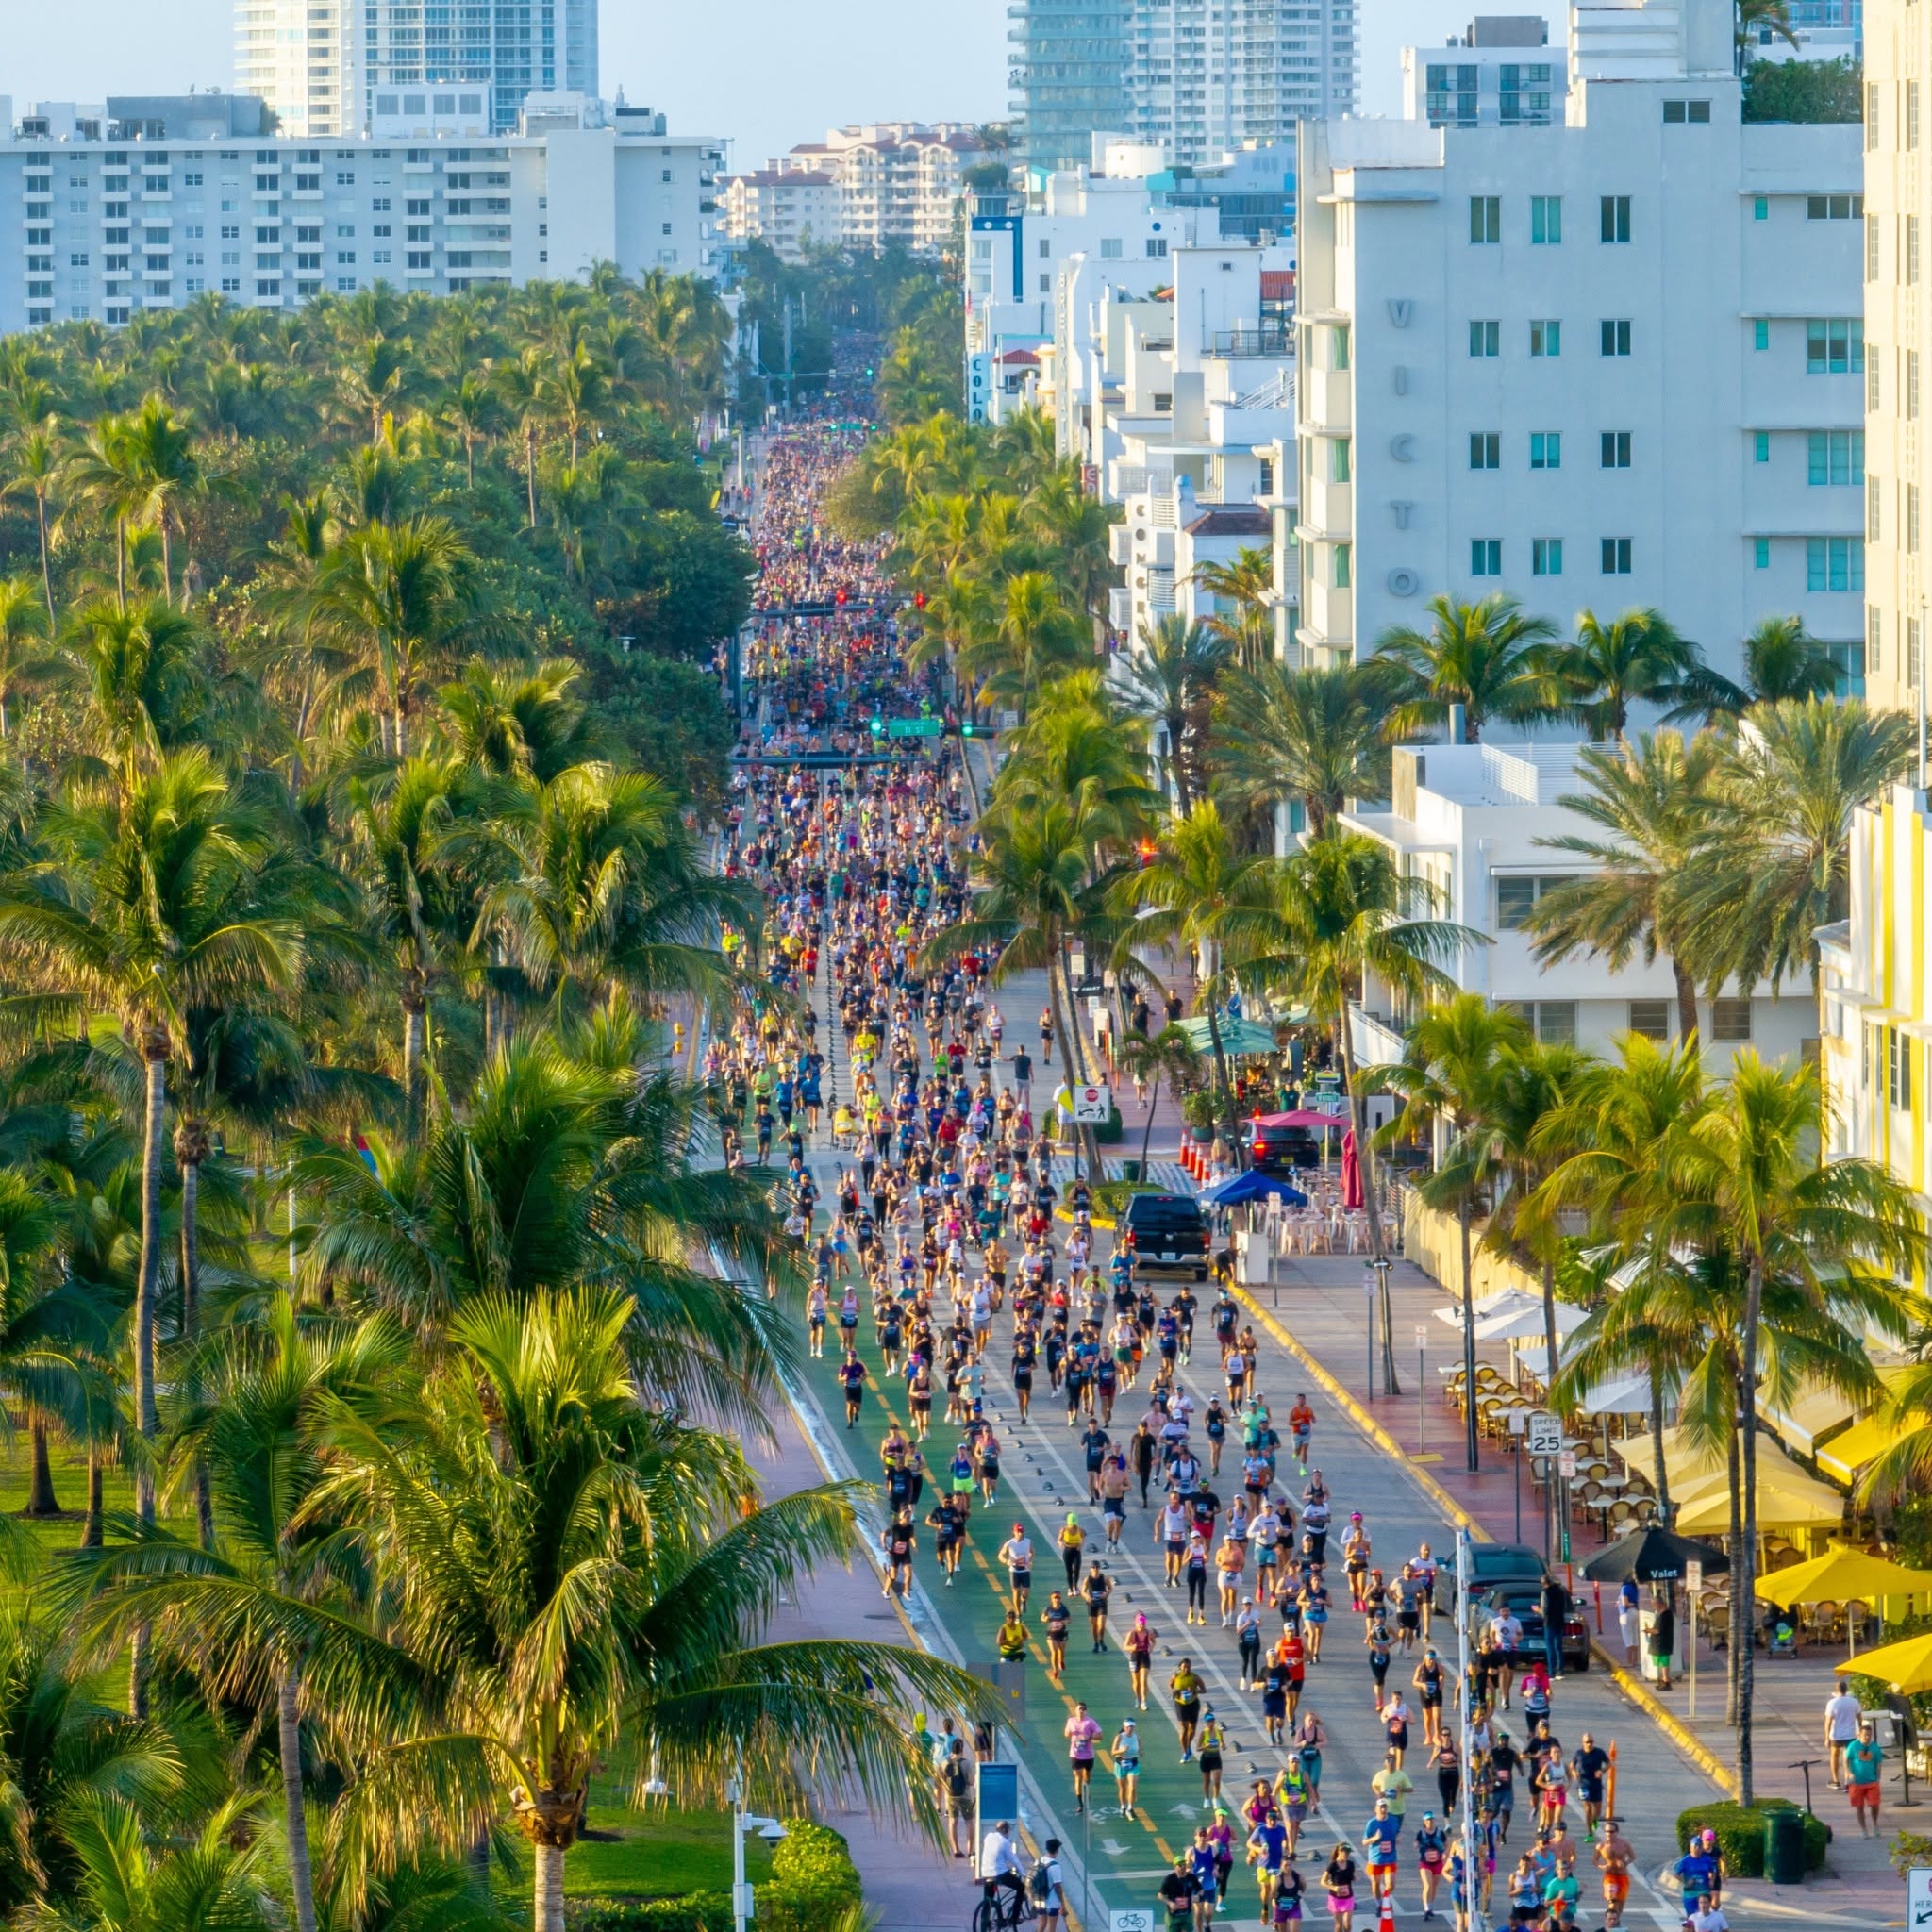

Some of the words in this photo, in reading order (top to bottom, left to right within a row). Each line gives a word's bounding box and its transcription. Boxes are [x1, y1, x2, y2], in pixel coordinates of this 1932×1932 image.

[973, 359, 983, 422] COLO
[1387, 298, 1419, 598] VICTO
[1534, 1436, 1559, 1451] 25
[1650, 1569, 1678, 1579] Valet
